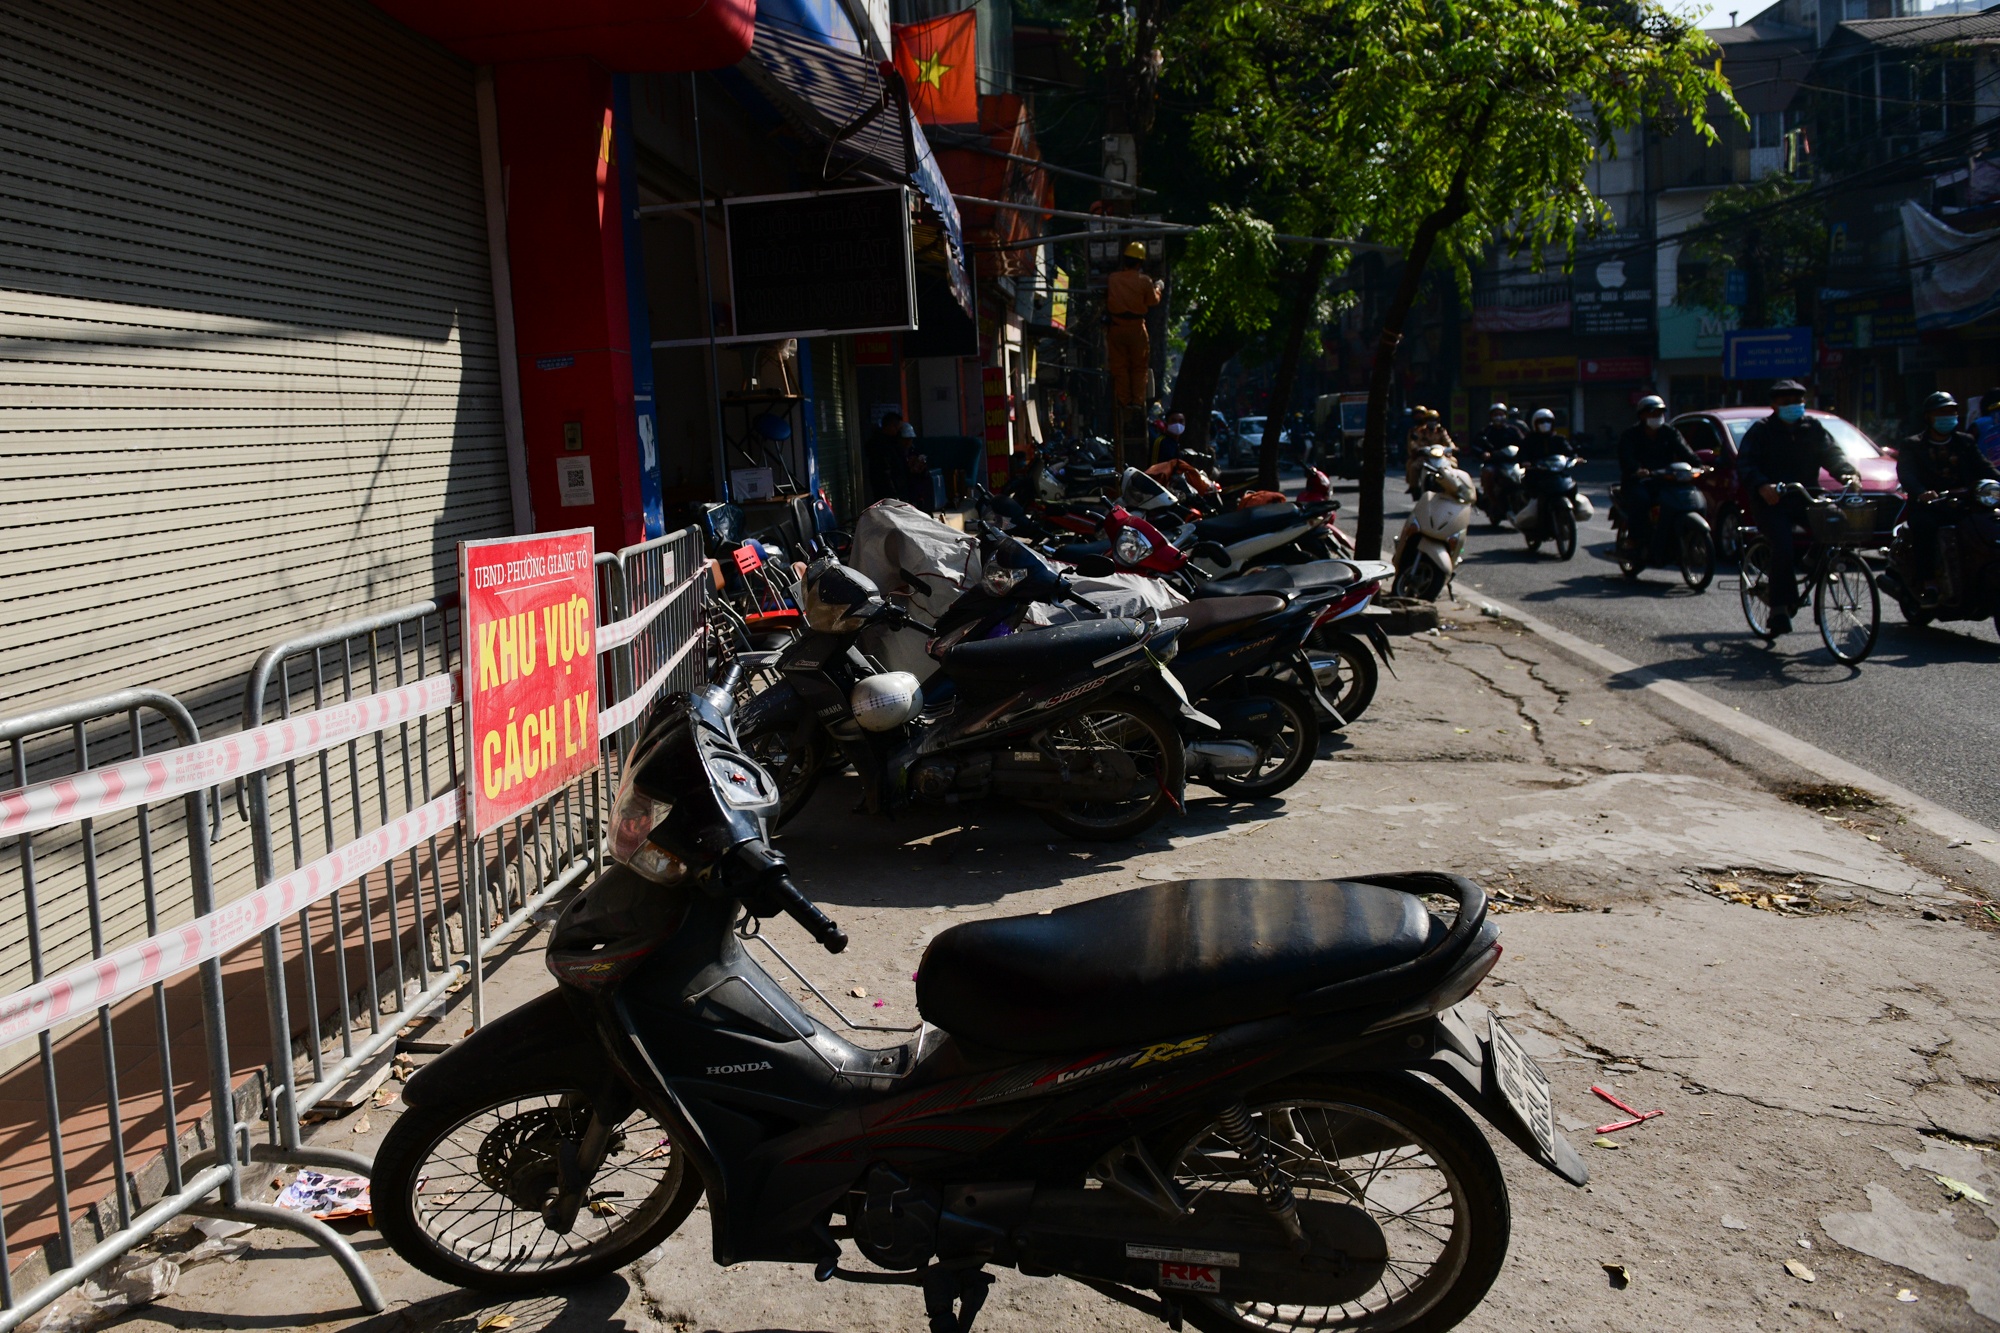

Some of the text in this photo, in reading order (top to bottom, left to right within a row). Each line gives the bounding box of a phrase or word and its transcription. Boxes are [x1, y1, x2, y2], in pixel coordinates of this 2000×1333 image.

[744, 233, 890, 277] HÒA PHÁT
[474, 562, 506, 590] UBND
[507, 551, 546, 583] PHƯỜNG
[547, 544, 575, 575] GIẢNG
[479, 593, 590, 693] KHU VỰC
[1227, 634, 1279, 658] VISION
[482, 690, 590, 801] CÁCH LY
[706, 1060, 774, 1076] HONDA
[1162, 1262, 1217, 1283] RK
[1162, 1279, 1218, 1291] Racing Chain
